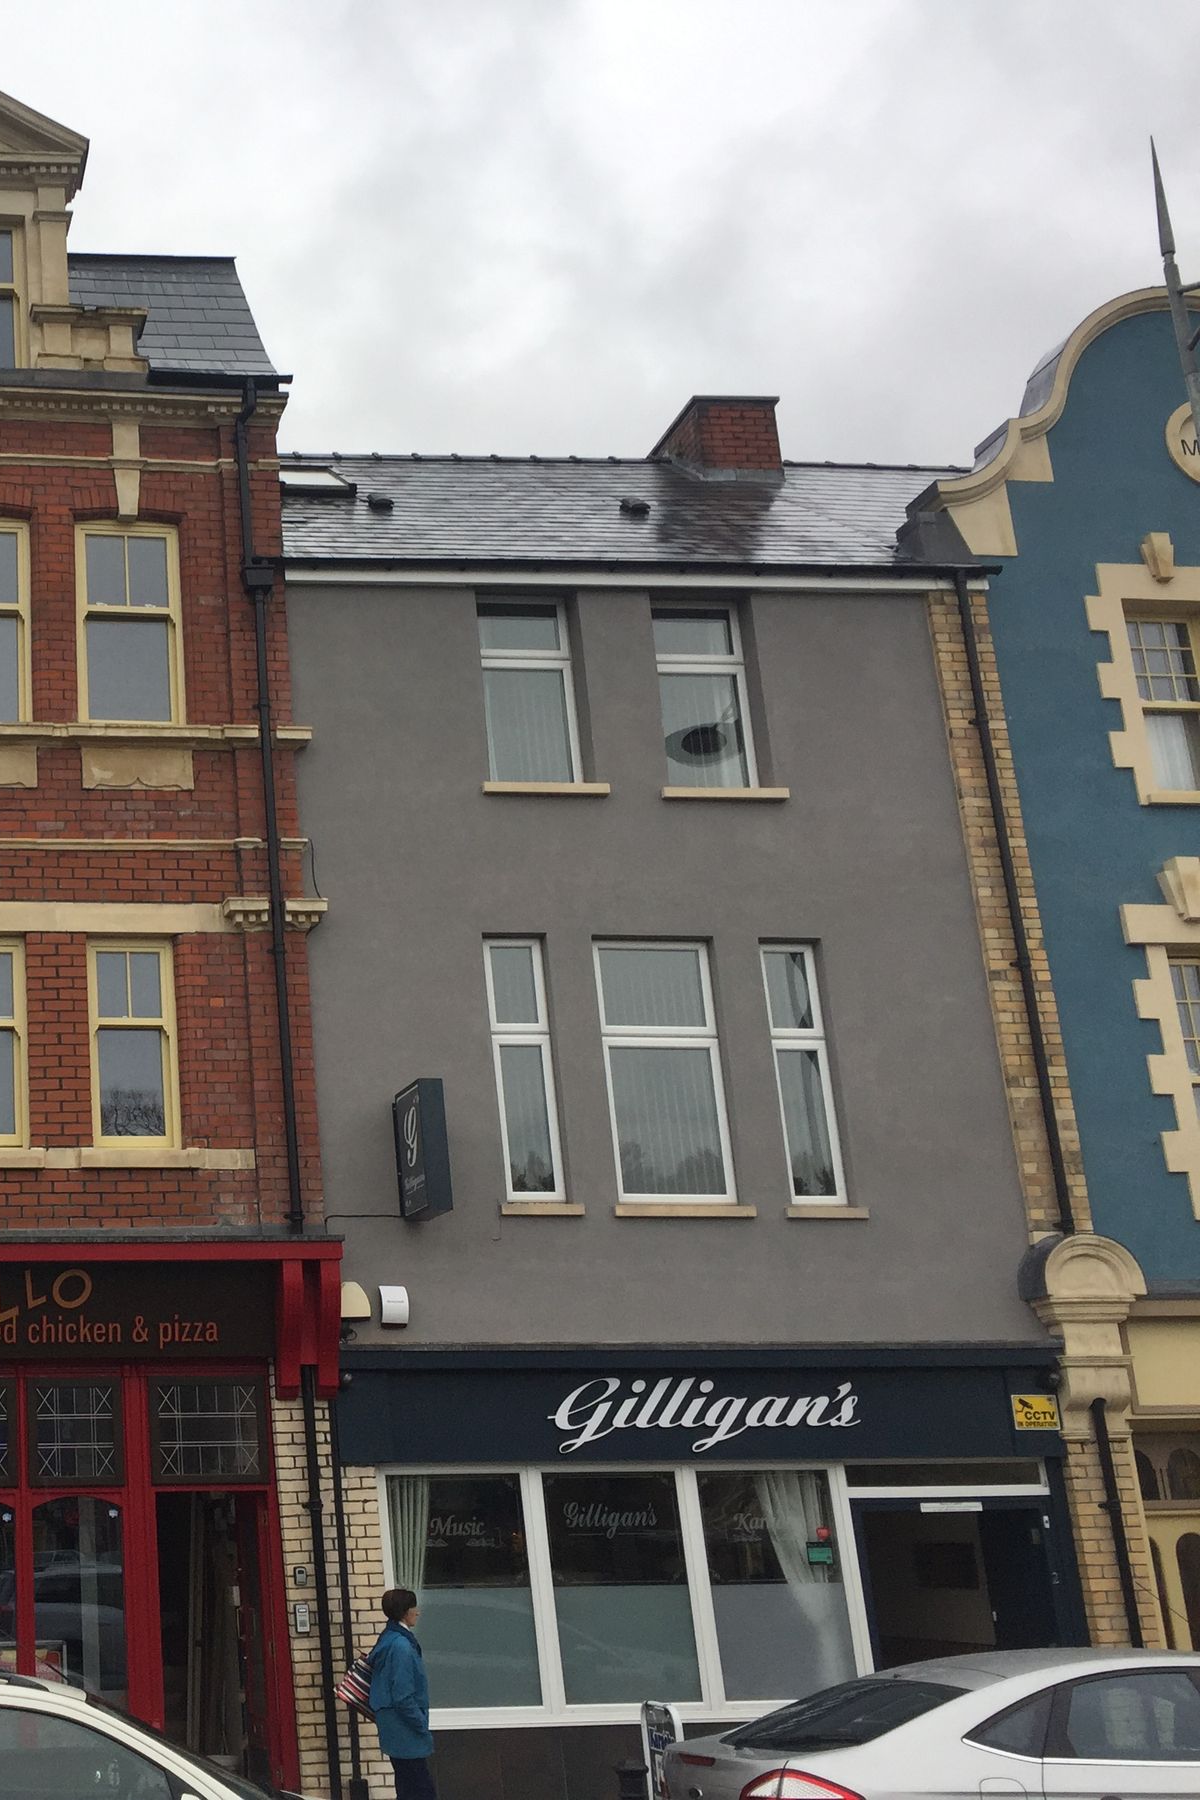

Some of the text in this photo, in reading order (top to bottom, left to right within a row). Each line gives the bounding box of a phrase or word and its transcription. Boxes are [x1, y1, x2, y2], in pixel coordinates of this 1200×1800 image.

[28, 1316, 121, 1344] chicken
[132, 1316, 149, 1344] &
[159, 1314, 219, 1349] pizza
[547, 1376, 861, 1454] Gilligan's
[1024, 1411, 1055, 1420] CCTV
[430, 1515, 486, 1537] Music
[563, 1501, 657, 1539] Gilligan's
